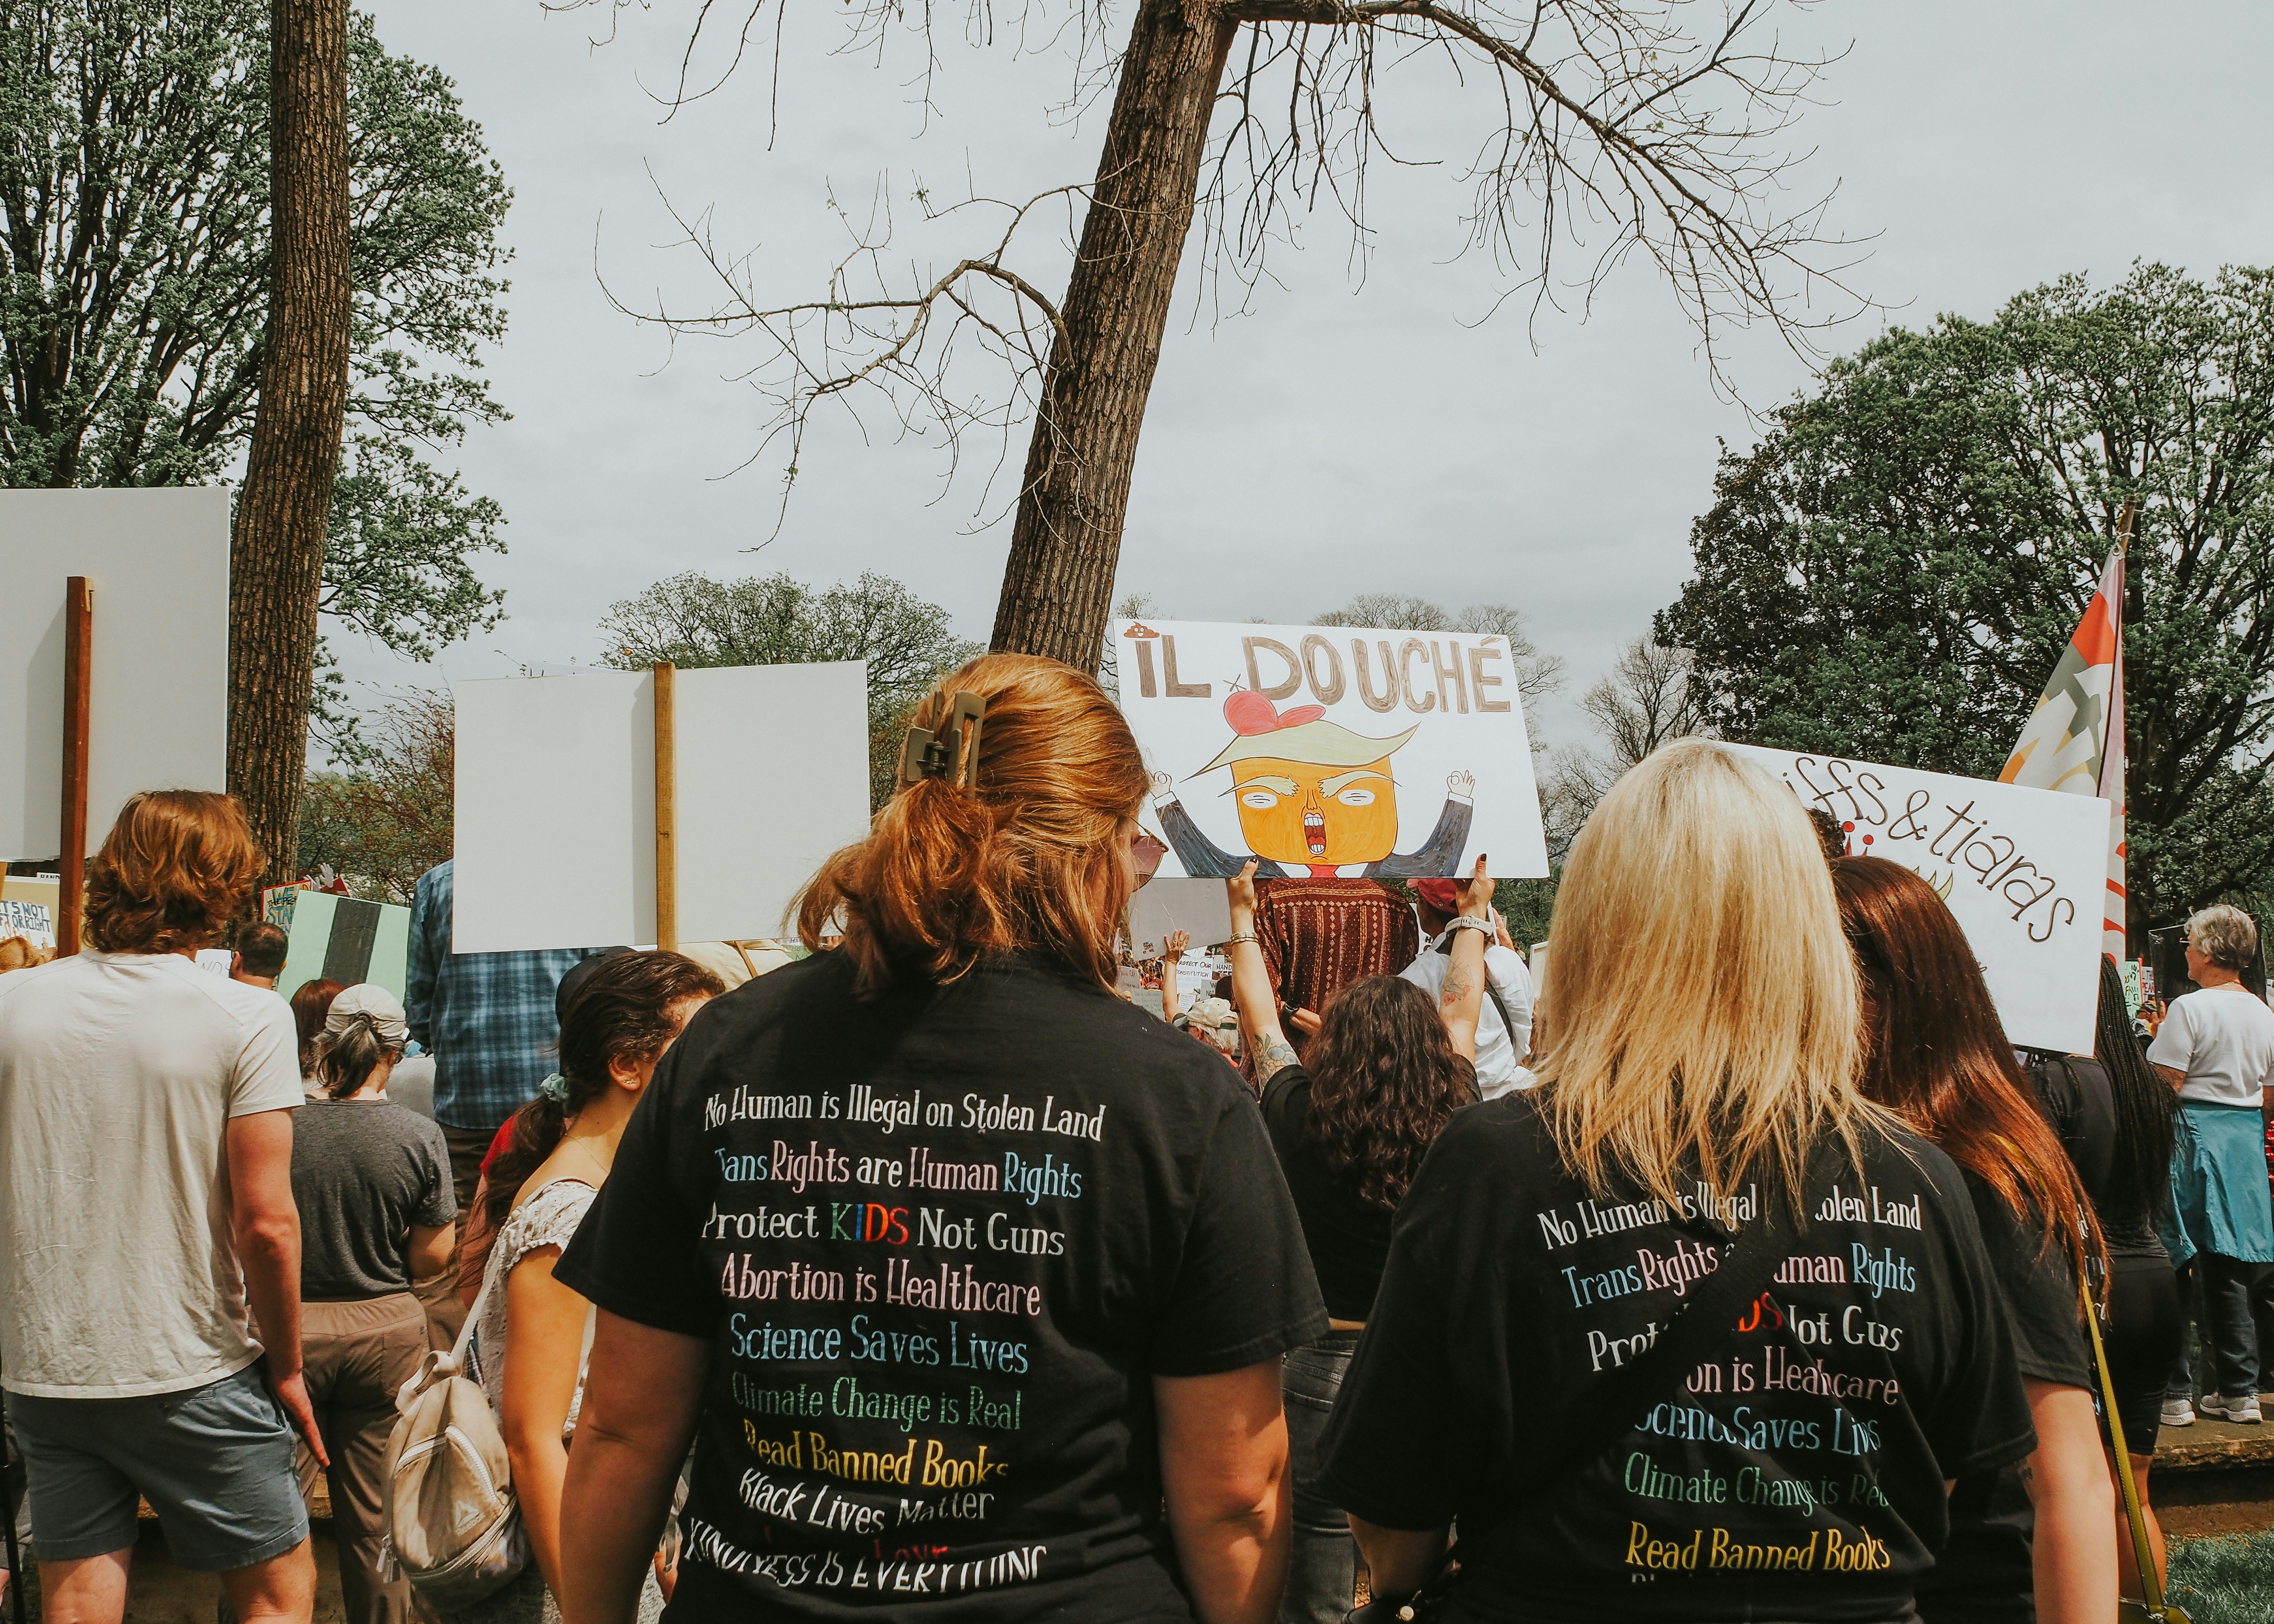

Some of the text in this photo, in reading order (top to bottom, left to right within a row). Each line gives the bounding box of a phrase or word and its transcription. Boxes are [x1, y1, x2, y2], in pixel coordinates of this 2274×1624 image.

[1241, 633, 1511, 714] DOUCHÉ
[1781, 757, 2074, 943] iffs & tiaras
[22, 902, 44, 918] NOT
[705, 1084, 1106, 1141] No Human is Illegal on Stolen Land
[715, 1140, 1082, 1205] Tans Rights are Human Rights
[702, 1202, 1065, 1255] Protect KIDS Not Guns
[1537, 1210, 1577, 1249] No
[1576, 1195, 1670, 1238] Human
[1675, 1191, 1697, 1220] is
[1815, 1184, 1921, 1230] olen Land
[722, 1253, 1040, 1316] Abortion is Healthcare
[1561, 1239, 1718, 1308] Trans Rights
[1773, 1243, 1915, 1298] uman Rights
[731, 1313, 1028, 1373] Science Saves Lives
[1587, 1316, 1668, 1372] Prot
[733, 1373, 1020, 1432] Climate Change is Real
[1733, 1357, 1755, 1392] is
[1734, 1406, 1819, 1451] Saves
[810, 1432, 917, 1484] Banned
[1625, 1452, 1726, 1503] Climate
[1737, 1467, 1819, 1517] Change
[1821, 1475, 1840, 1503] is
[808, 1485, 885, 1533] Lives
[897, 1493, 994, 1526] Matter
[816, 1552, 843, 1586] IS
[1625, 1521, 1890, 1571] Read Banned Books
